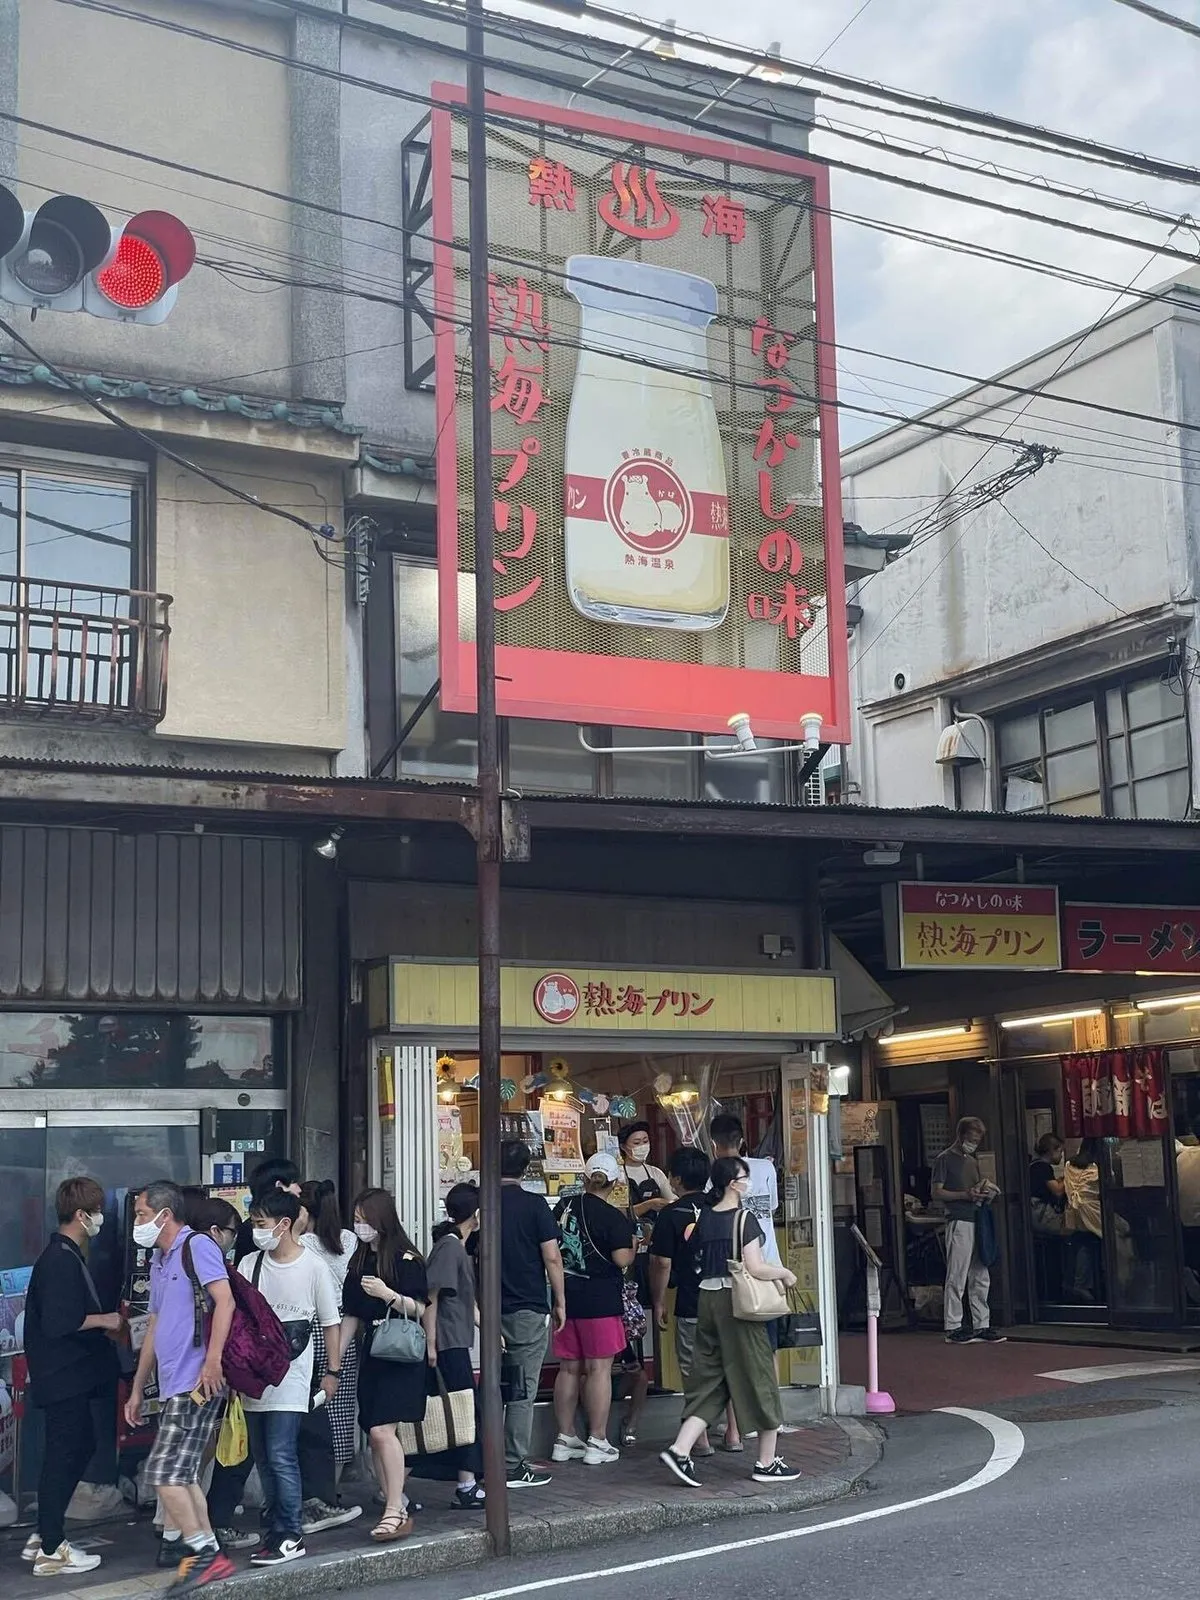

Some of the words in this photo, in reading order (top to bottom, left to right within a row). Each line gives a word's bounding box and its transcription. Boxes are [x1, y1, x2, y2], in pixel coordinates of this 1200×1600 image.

[528, 157, 577, 212] 熱
[702, 194, 748, 244] 海
[488, 272, 552, 612] 熱海プリン
[747, 315, 813, 640] なつかしの味
[624, 554, 675, 571] 熱海温泉
[935, 890, 1024, 912] なつかしの味
[917, 920, 1046, 959] 熱海プリン
[582, 981, 715, 1018] 熱海プリン
